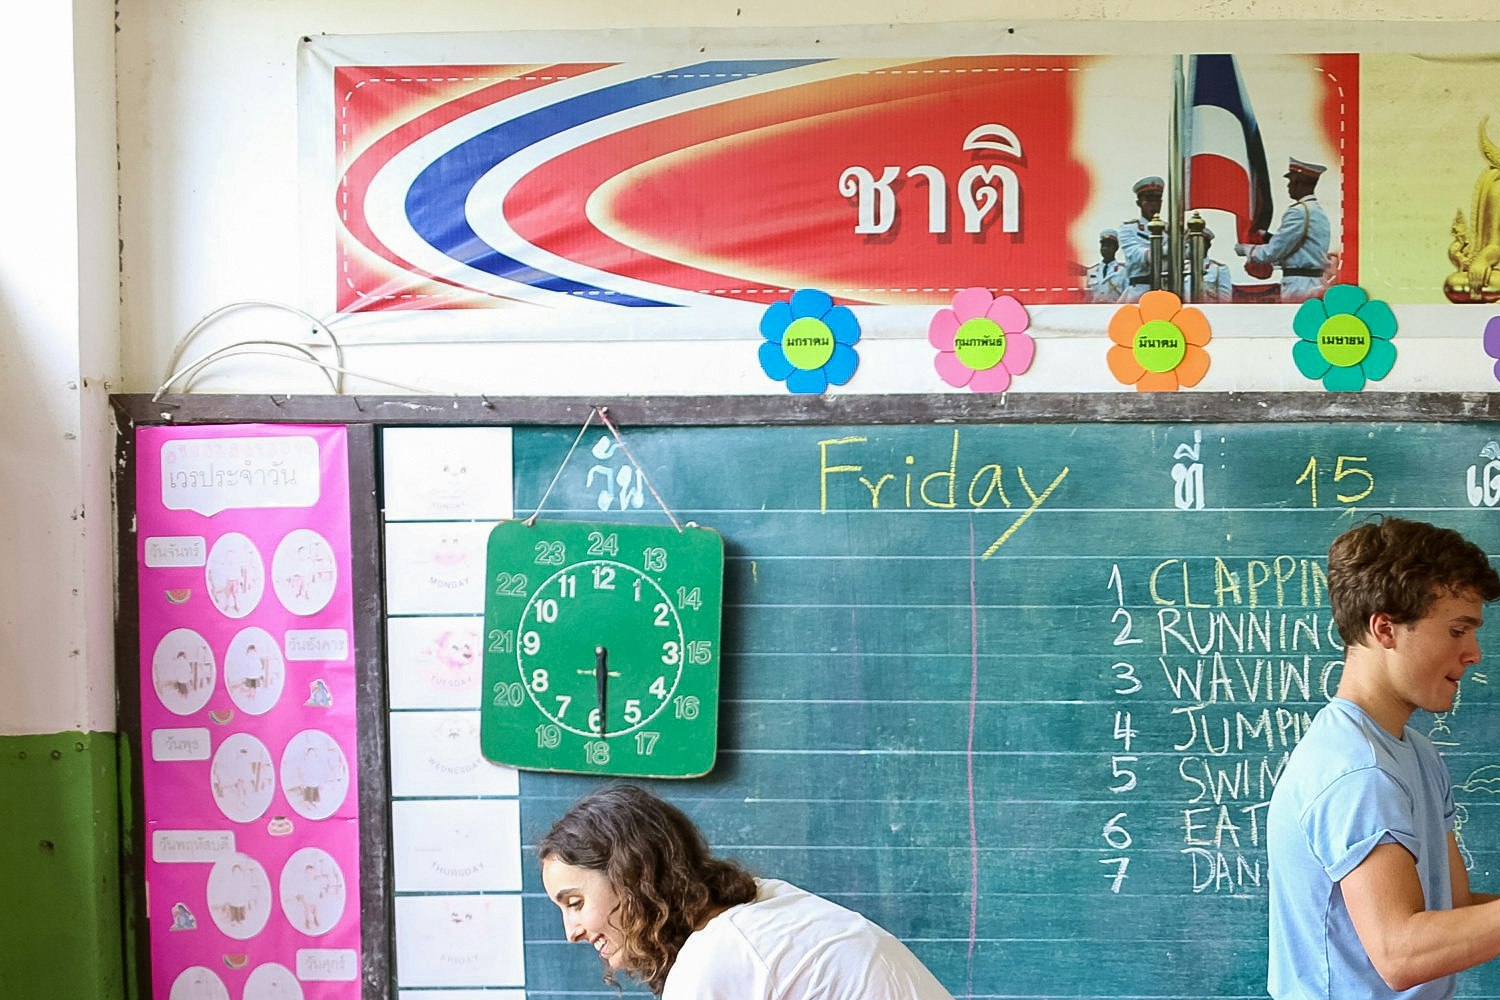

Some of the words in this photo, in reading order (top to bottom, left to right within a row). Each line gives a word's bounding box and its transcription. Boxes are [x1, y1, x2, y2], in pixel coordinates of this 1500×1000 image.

[839, 123, 1022, 234] ชาติ
[786, 336, 829, 347] มกราคม
[954, 334, 1004, 351] กุมภาพันธ์
[1138, 335, 1178, 349] มีนาคม
[1321, 334, 1365, 346] เมษายน
[169, 458, 297, 489] เวรประจำวัน
[586, 436, 644, 512] วัน
[818, 429, 1069, 560] Friday
[1171, 429, 1206, 511] ที่
[1296, 456, 1374, 508] 15
[535, 541, 566, 564] 23
[588, 532, 619, 556] 24
[643, 548, 667, 571] 13
[428, 576, 470, 589] MONDAY
[496, 573, 527, 596] 22
[559, 575, 576, 598] 11
[592, 566, 615, 589] 12
[1107, 564, 1123, 605] 1
[1150, 555, 1328, 608] CLAPPIN
[632, 578, 641, 601] 1
[677, 587, 702, 610] 14
[534, 599, 558, 623] 10
[653, 603, 669, 626] 2
[1111, 608, 1143, 645] 2
[489, 630, 513, 652] 21
[523, 631, 541, 654] 9
[687, 641, 711, 664] 15
[661, 642, 679, 665] 3
[430, 675, 472, 688] TUESDAY
[532, 669, 549, 692] 8
[649, 677, 666, 699] 4
[1111, 662, 1143, 694] 3
[493, 682, 525, 706] 20
[556, 696, 571, 718] 7
[624, 700, 641, 723] 5
[674, 696, 699, 719] 16
[588, 708, 602, 732] 6
[1113, 711, 1139, 750] 4
[1171, 701, 1312, 756] JUMPI
[535, 725, 560, 747] 19
[635, 732, 659, 754] 17
[584, 742, 609, 765] 18
[427, 756, 482, 775] WEDNESDAY
[1109, 756, 1139, 792] 5
[1179, 751, 1290, 804] SWIM
[1102, 813, 1132, 850] 6
[1180, 801, 1270, 849] EAT
[432, 860, 485, 877] THURSDAY
[1099, 857, 1130, 894] 7
